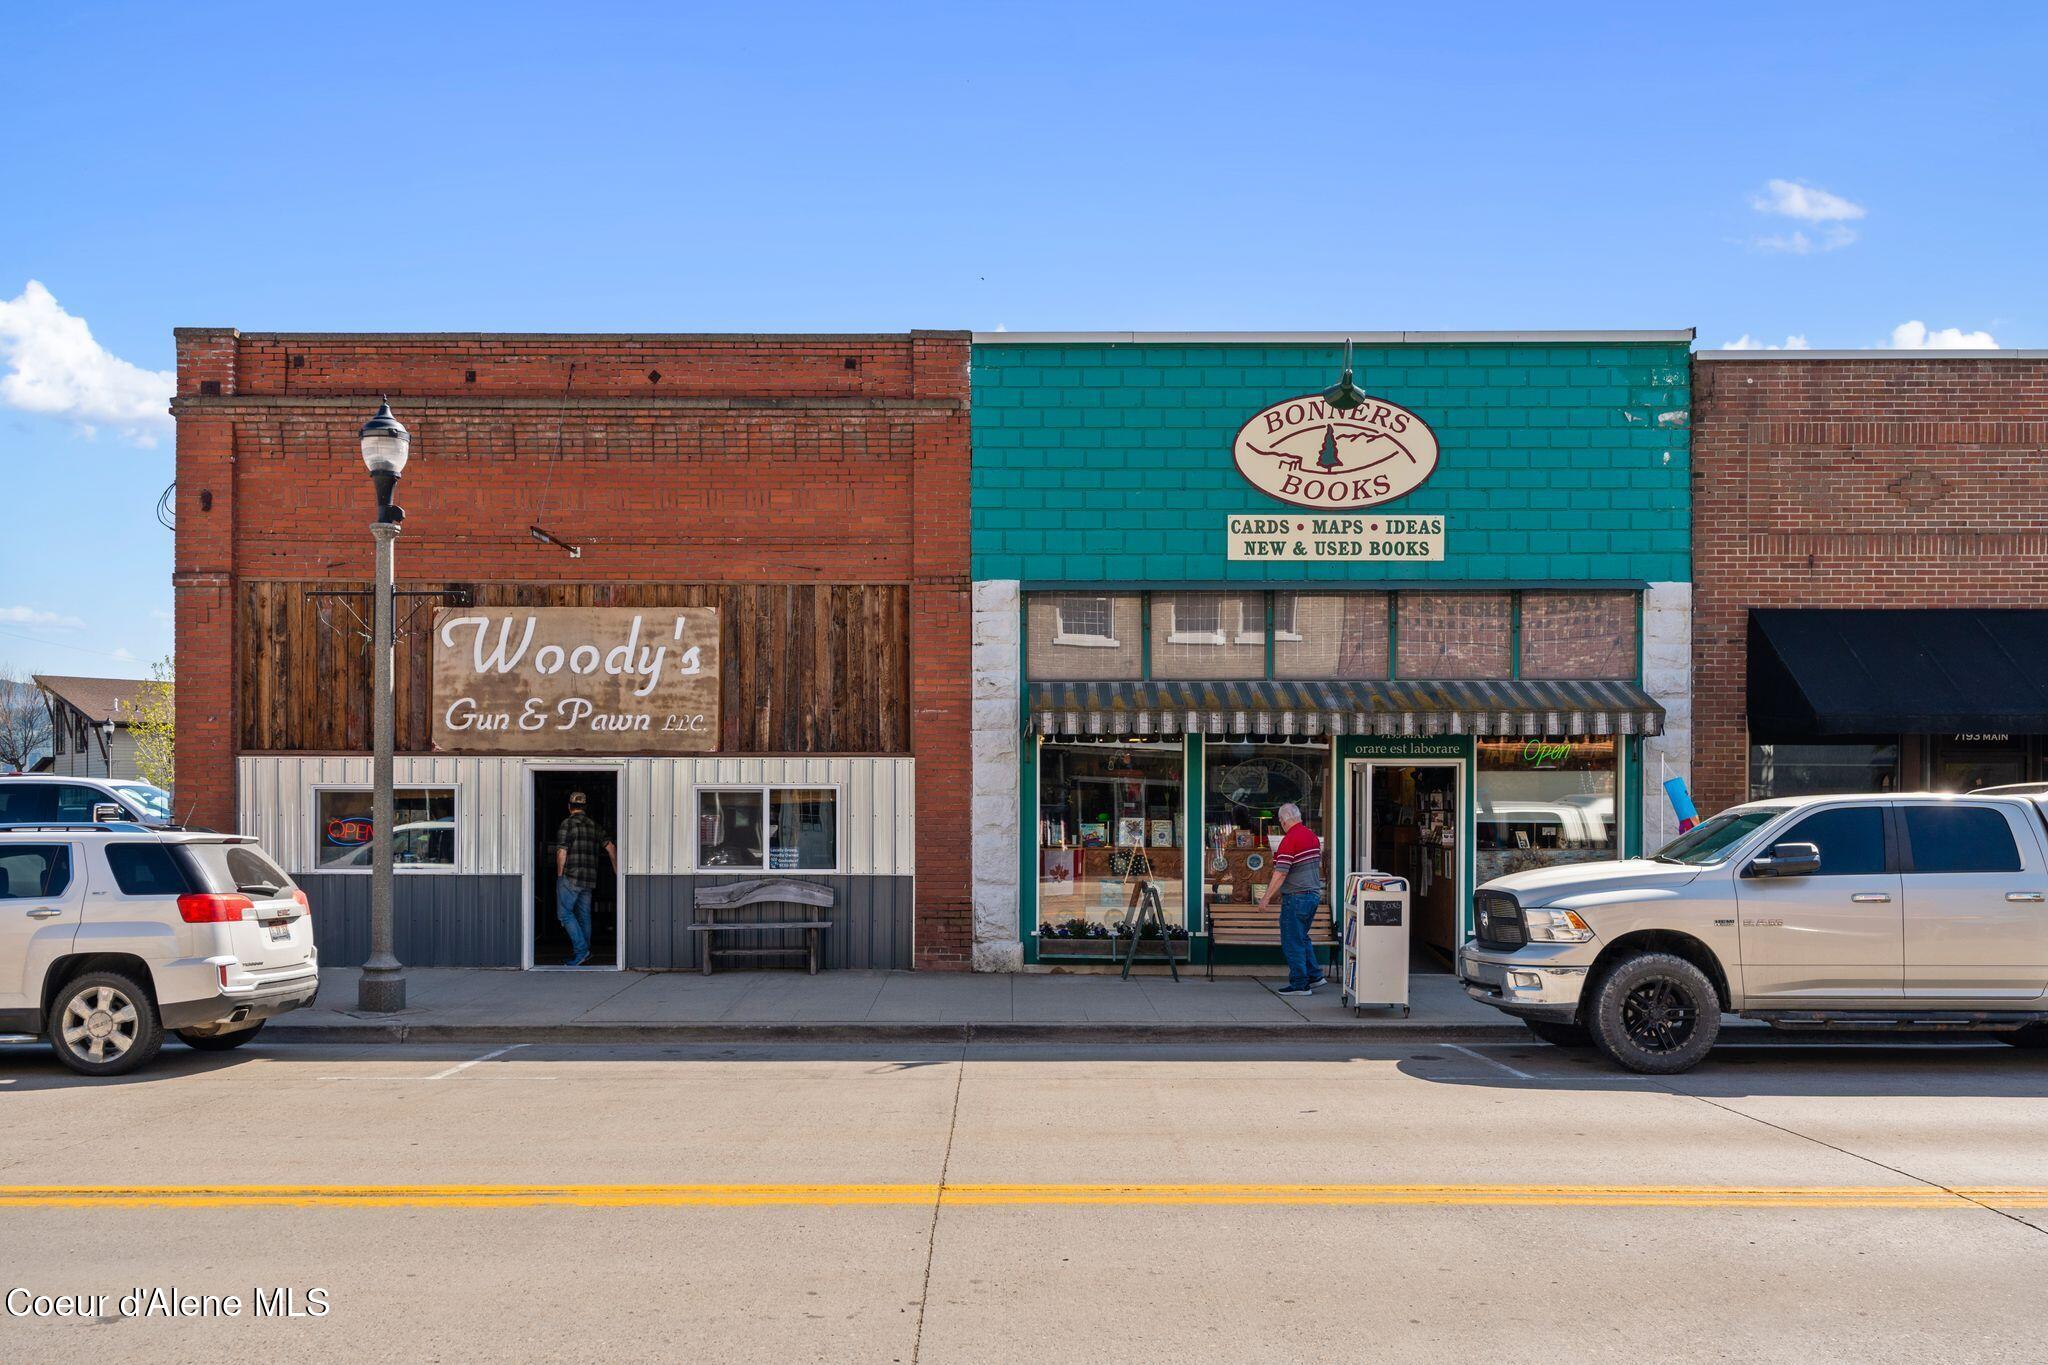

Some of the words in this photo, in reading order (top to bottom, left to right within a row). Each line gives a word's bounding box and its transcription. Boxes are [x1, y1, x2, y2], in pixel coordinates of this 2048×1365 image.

[1263, 400, 1411, 435] BONNERS
[1279, 474, 1391, 501] BOOKS
[1230, 519, 1290, 535] CARDS
[1312, 519, 1364, 535] MAPS
[1385, 519, 1442, 535] IDEAS
[1244, 541, 1287, 556] NEW
[1292, 541, 1308, 556] &
[1315, 541, 1363, 556] USED
[1369, 541, 1430, 556] BOOKS
[440, 615, 702, 697] Woody's
[445, 697, 509, 731] Gun
[518, 697, 548, 731] &
[557, 697, 650, 731] Pawn
[1355, 745, 1387, 754] orare
[1390, 744, 1407, 754] est
[1410, 743, 1460, 754] laborare
[1983, 733, 2009, 741] MAIN
[1524, 739, 1571, 767] Open
